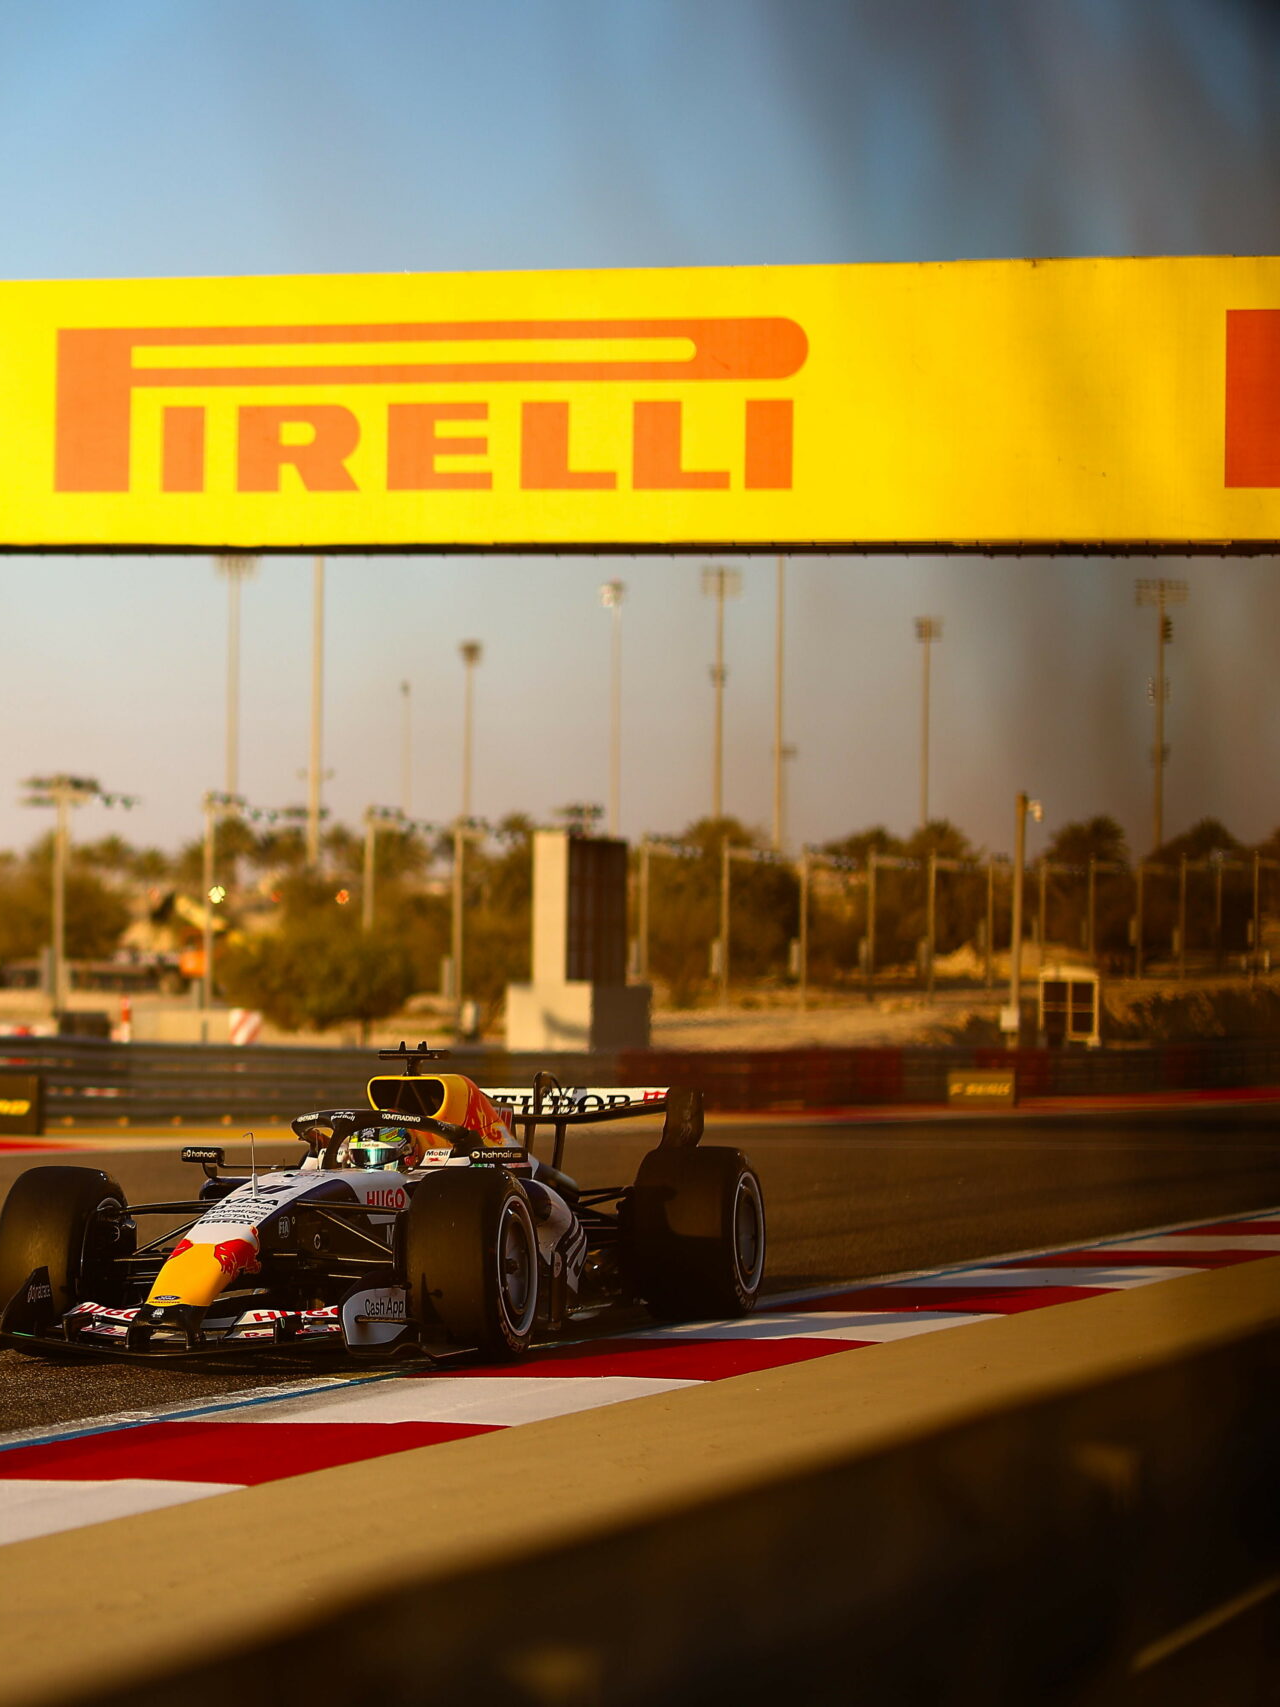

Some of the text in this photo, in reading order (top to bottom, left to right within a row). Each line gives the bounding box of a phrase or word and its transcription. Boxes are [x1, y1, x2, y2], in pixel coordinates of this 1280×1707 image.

[53, 316, 809, 493] PIRELLI
[481, 1150, 512, 1158] hahnair
[224, 1197, 279, 1206] VISA
[366, 1187, 406, 1209] HUGO
[364, 1298, 404, 1316] Cash App
